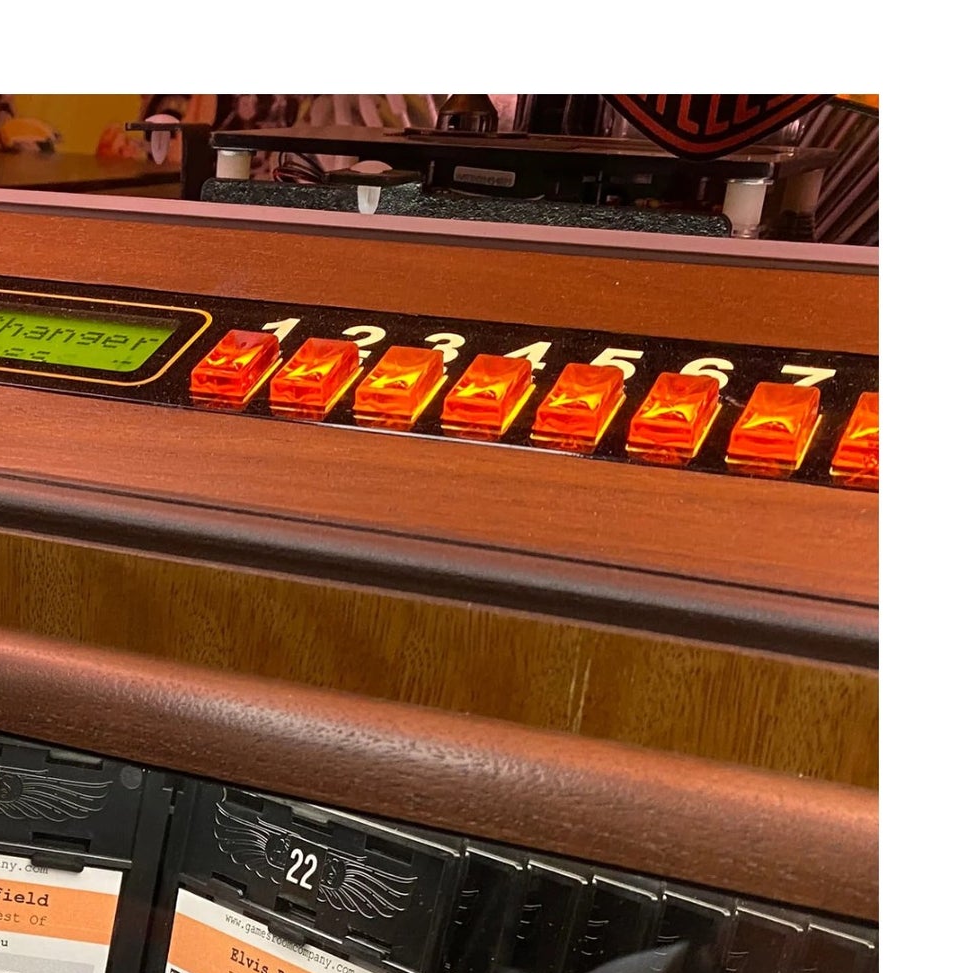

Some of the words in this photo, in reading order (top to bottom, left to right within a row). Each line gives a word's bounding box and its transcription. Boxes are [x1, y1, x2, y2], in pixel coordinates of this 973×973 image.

[262, 318, 300, 343] 1
[342, 325, 386, 362] 2
[424, 333, 465, 363] 3
[503, 341, 552, 370] 4
[589, 348, 644, 380] 5
[679, 358, 734, 389] 6
[286, 848, 317, 890] 22
[29, 915, 47, 926] Of
